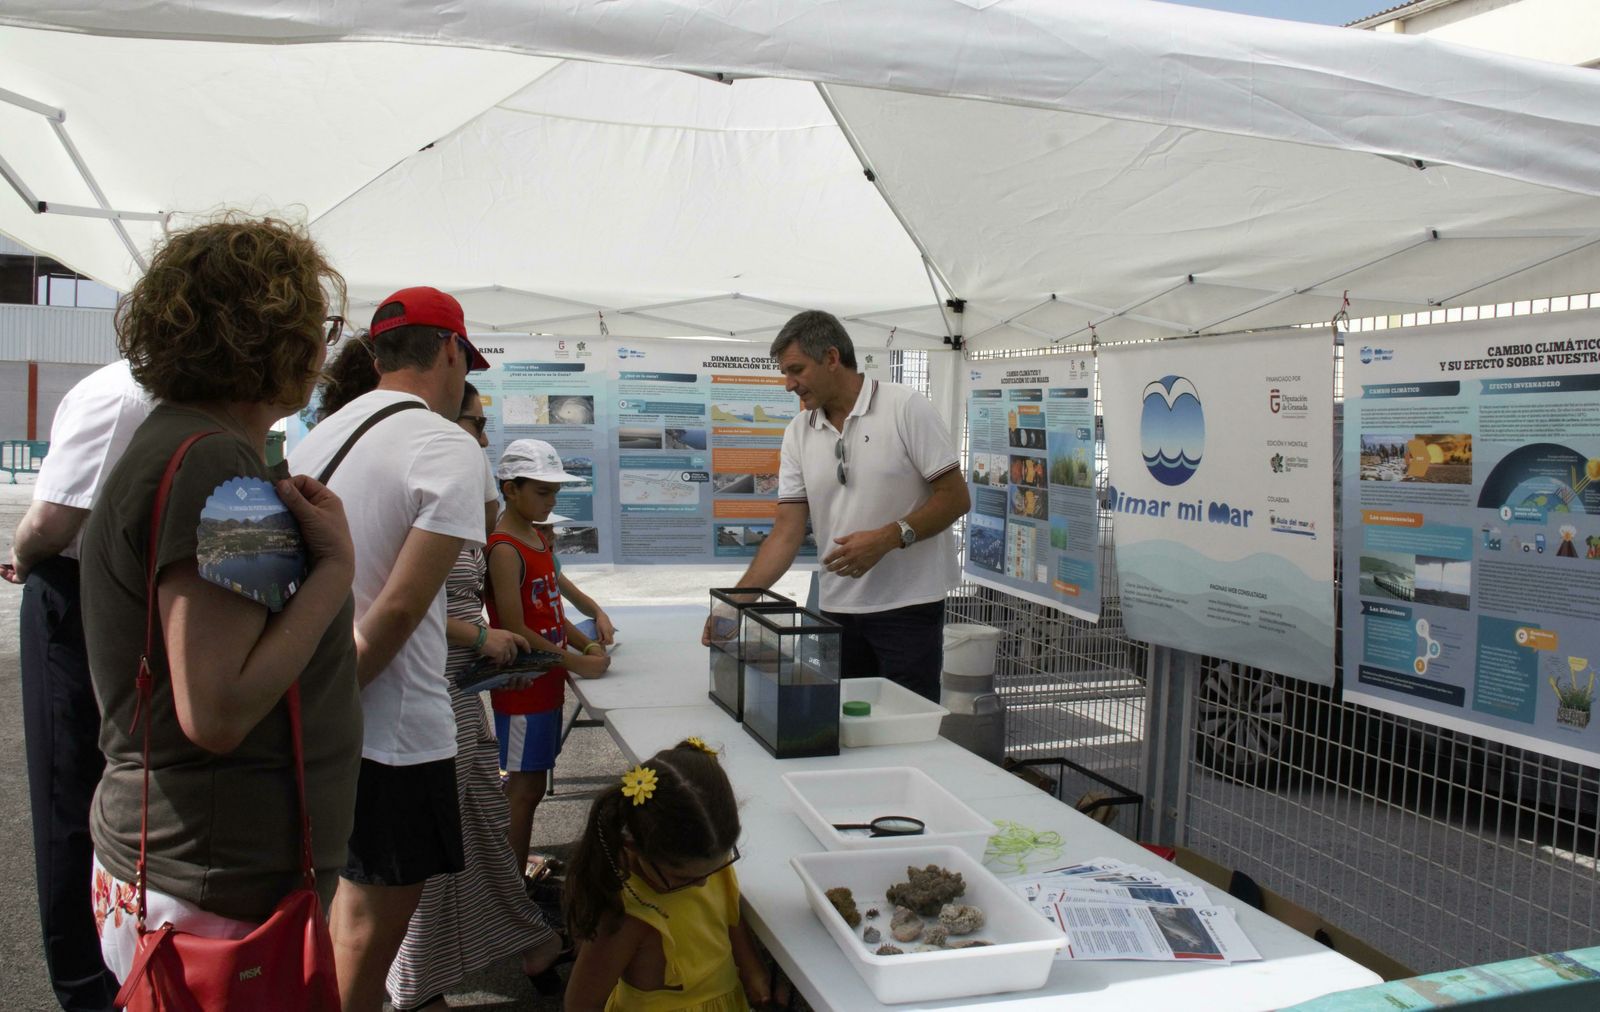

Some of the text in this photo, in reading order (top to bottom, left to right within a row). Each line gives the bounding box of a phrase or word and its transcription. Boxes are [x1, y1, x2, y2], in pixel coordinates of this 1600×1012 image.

[1488, 344, 1533, 357] CAMBIO
[711, 355, 750, 363] DINÁMICA
[1439, 351, 1600, 371] Y SU EFECTO SOBRE NUESTR
[702, 361, 760, 370] REGENERACIÓN
[1513, 380, 1560, 388] INVERNADERO
[1178, 500, 1203, 522] mi
[1208, 501, 1254, 528] Mar
